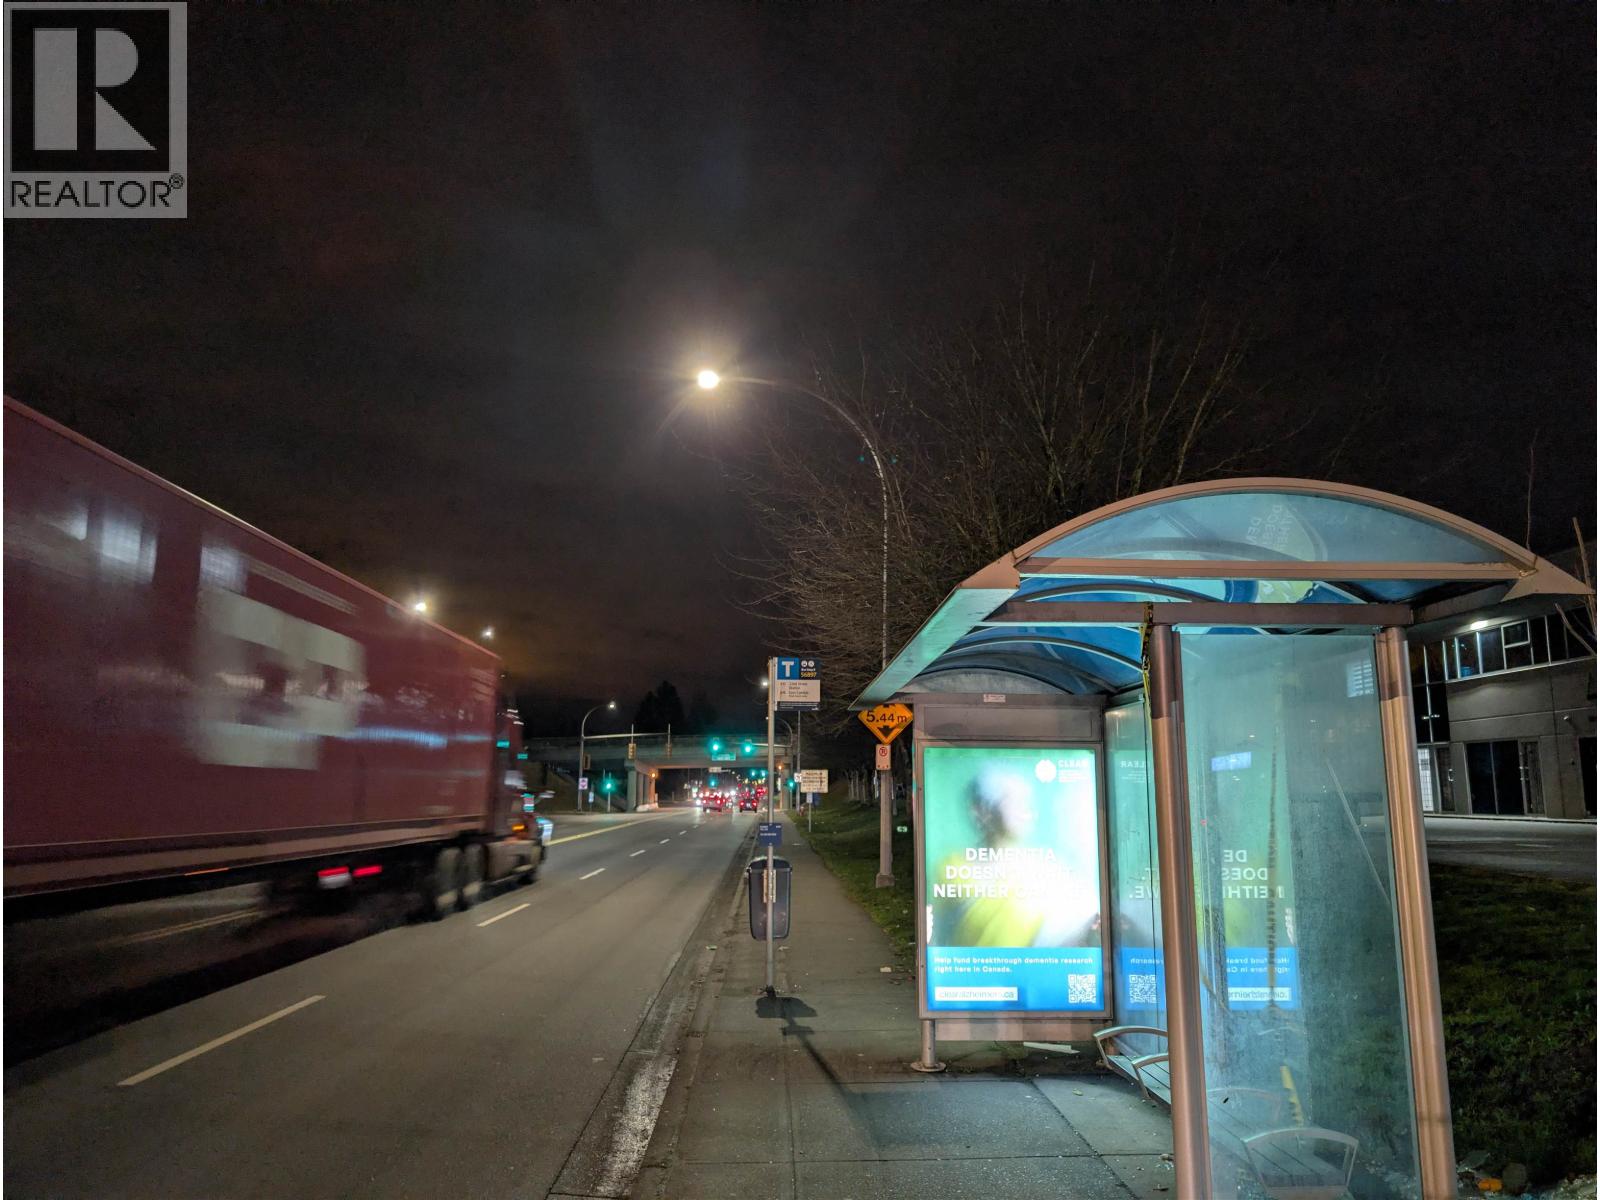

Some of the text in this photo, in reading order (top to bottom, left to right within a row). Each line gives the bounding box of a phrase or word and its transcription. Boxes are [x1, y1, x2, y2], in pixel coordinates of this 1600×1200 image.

[781, 661, 795, 678] T
[866, 711, 907, 723] 5.44 m
[965, 847, 1056, 862] DEMENTIA
[933, 884, 1010, 898] NEITHER
[934, 957, 951, 965] Help
[973, 957, 1022, 965] breakthrough
[934, 965, 952, 974] right
[954, 965, 971, 973] here
[982, 965, 1012, 973] Canada.
